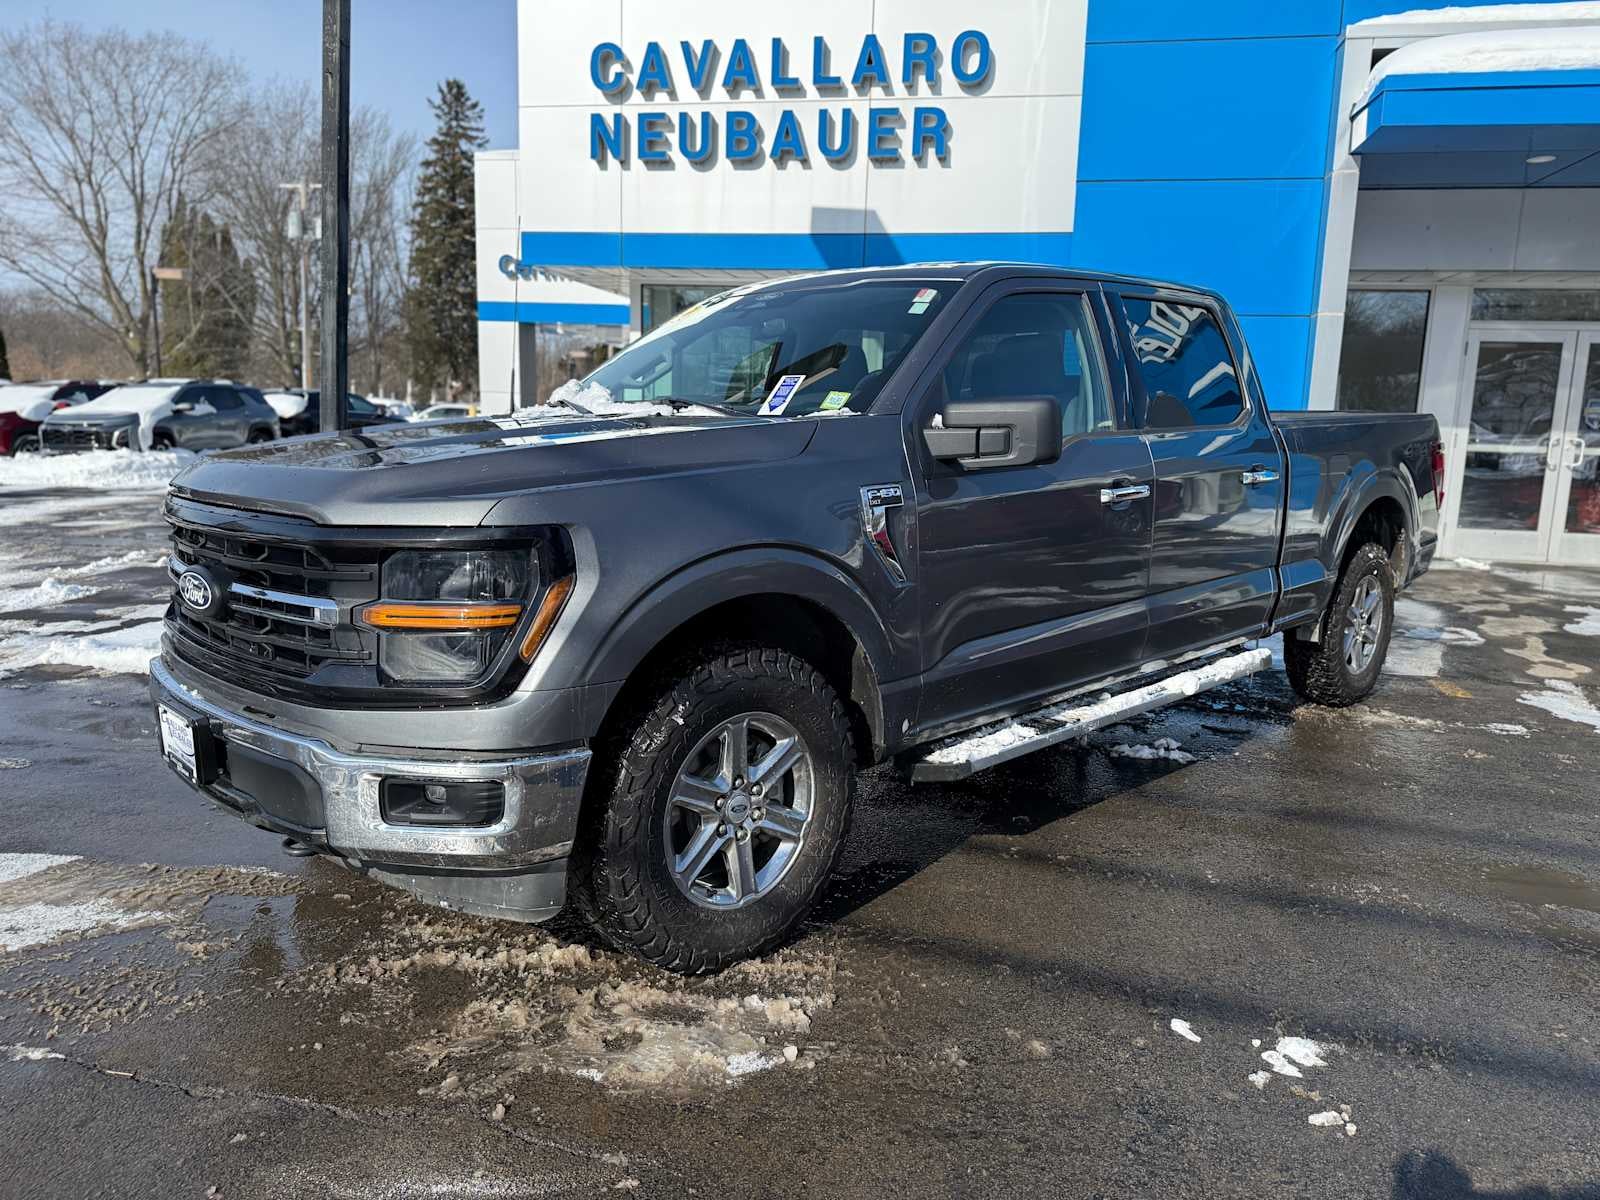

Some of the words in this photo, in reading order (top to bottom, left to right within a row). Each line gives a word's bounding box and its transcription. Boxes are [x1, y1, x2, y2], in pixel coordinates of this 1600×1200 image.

[590, 29, 992, 92] CAVALLARO
[590, 106, 949, 161] NEUBAUER
[868, 488, 900, 498] F-150
[184, 576, 205, 605] Ford
